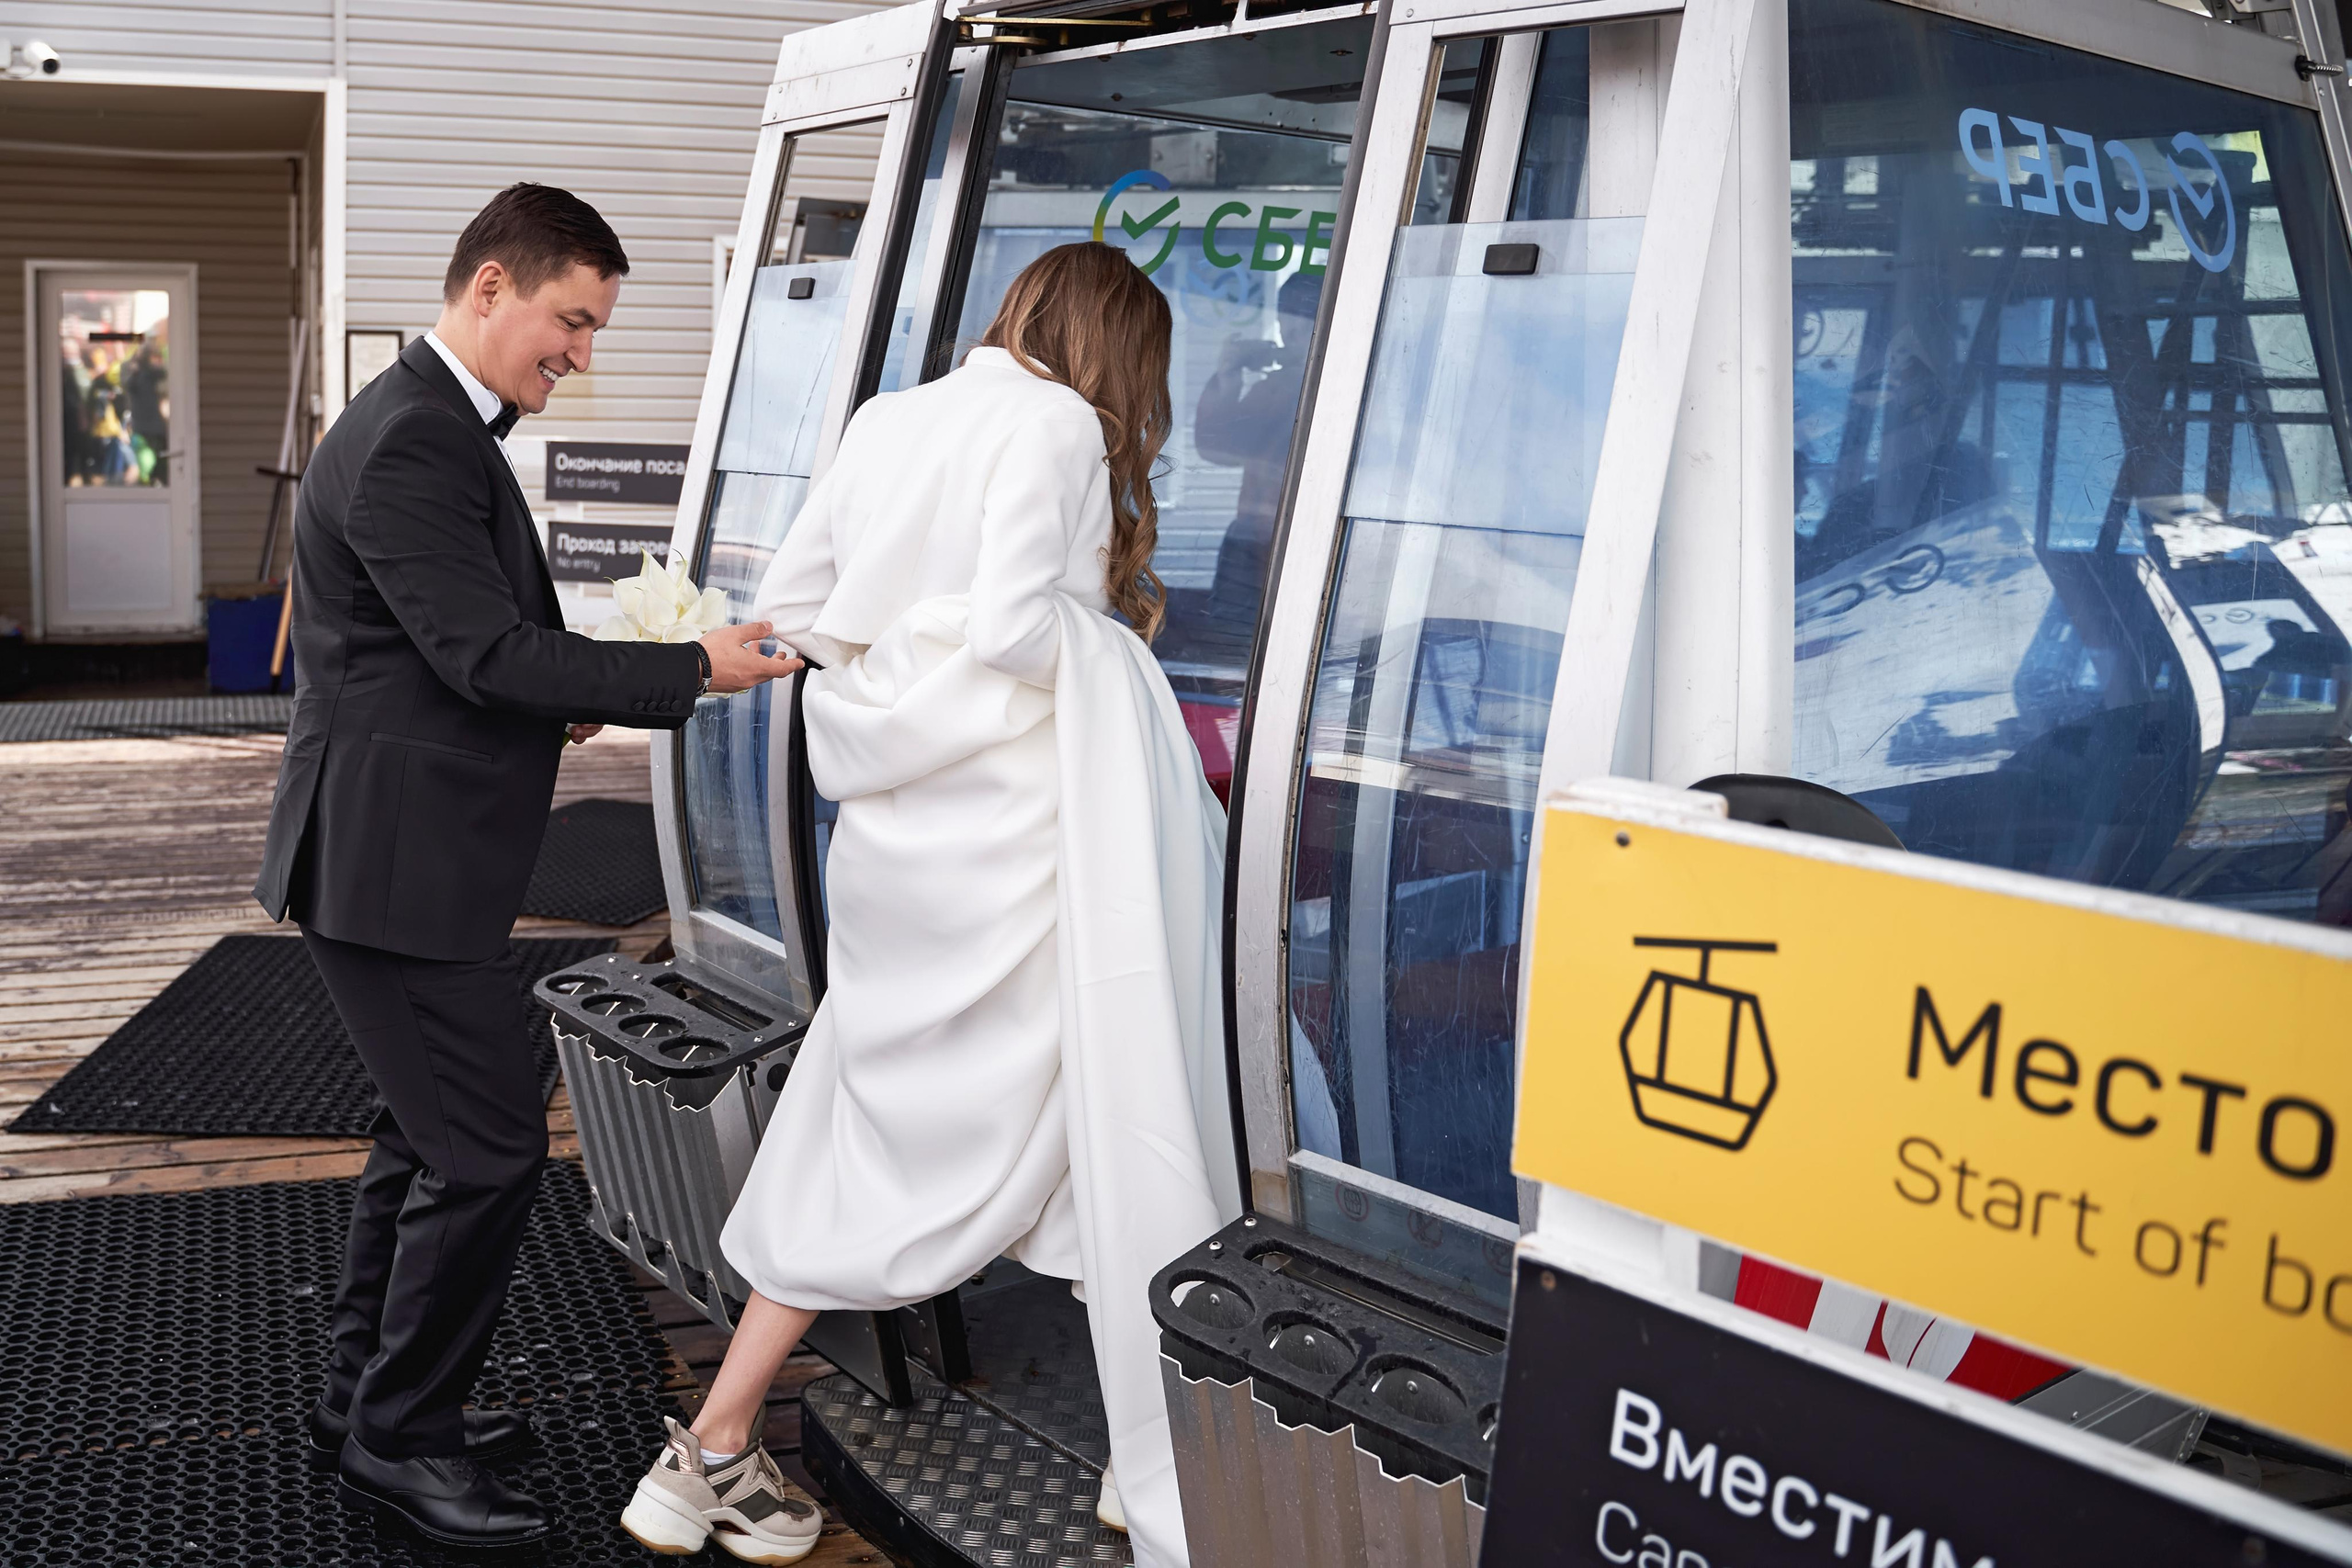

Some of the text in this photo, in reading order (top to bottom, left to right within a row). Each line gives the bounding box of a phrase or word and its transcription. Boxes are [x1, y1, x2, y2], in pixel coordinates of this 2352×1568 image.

[555, 452, 643, 474] Окончание
[555, 475, 621, 493] End boarding
[556, 533, 671, 557] Проход запре
[556, 557, 601, 573] No entry
[1905, 984, 2336, 1182] Место
[1894, 1136, 2102, 1258] Start
[2134, 1218, 2229, 1289] of
[1596, 1501, 1710, 1568] Ca
